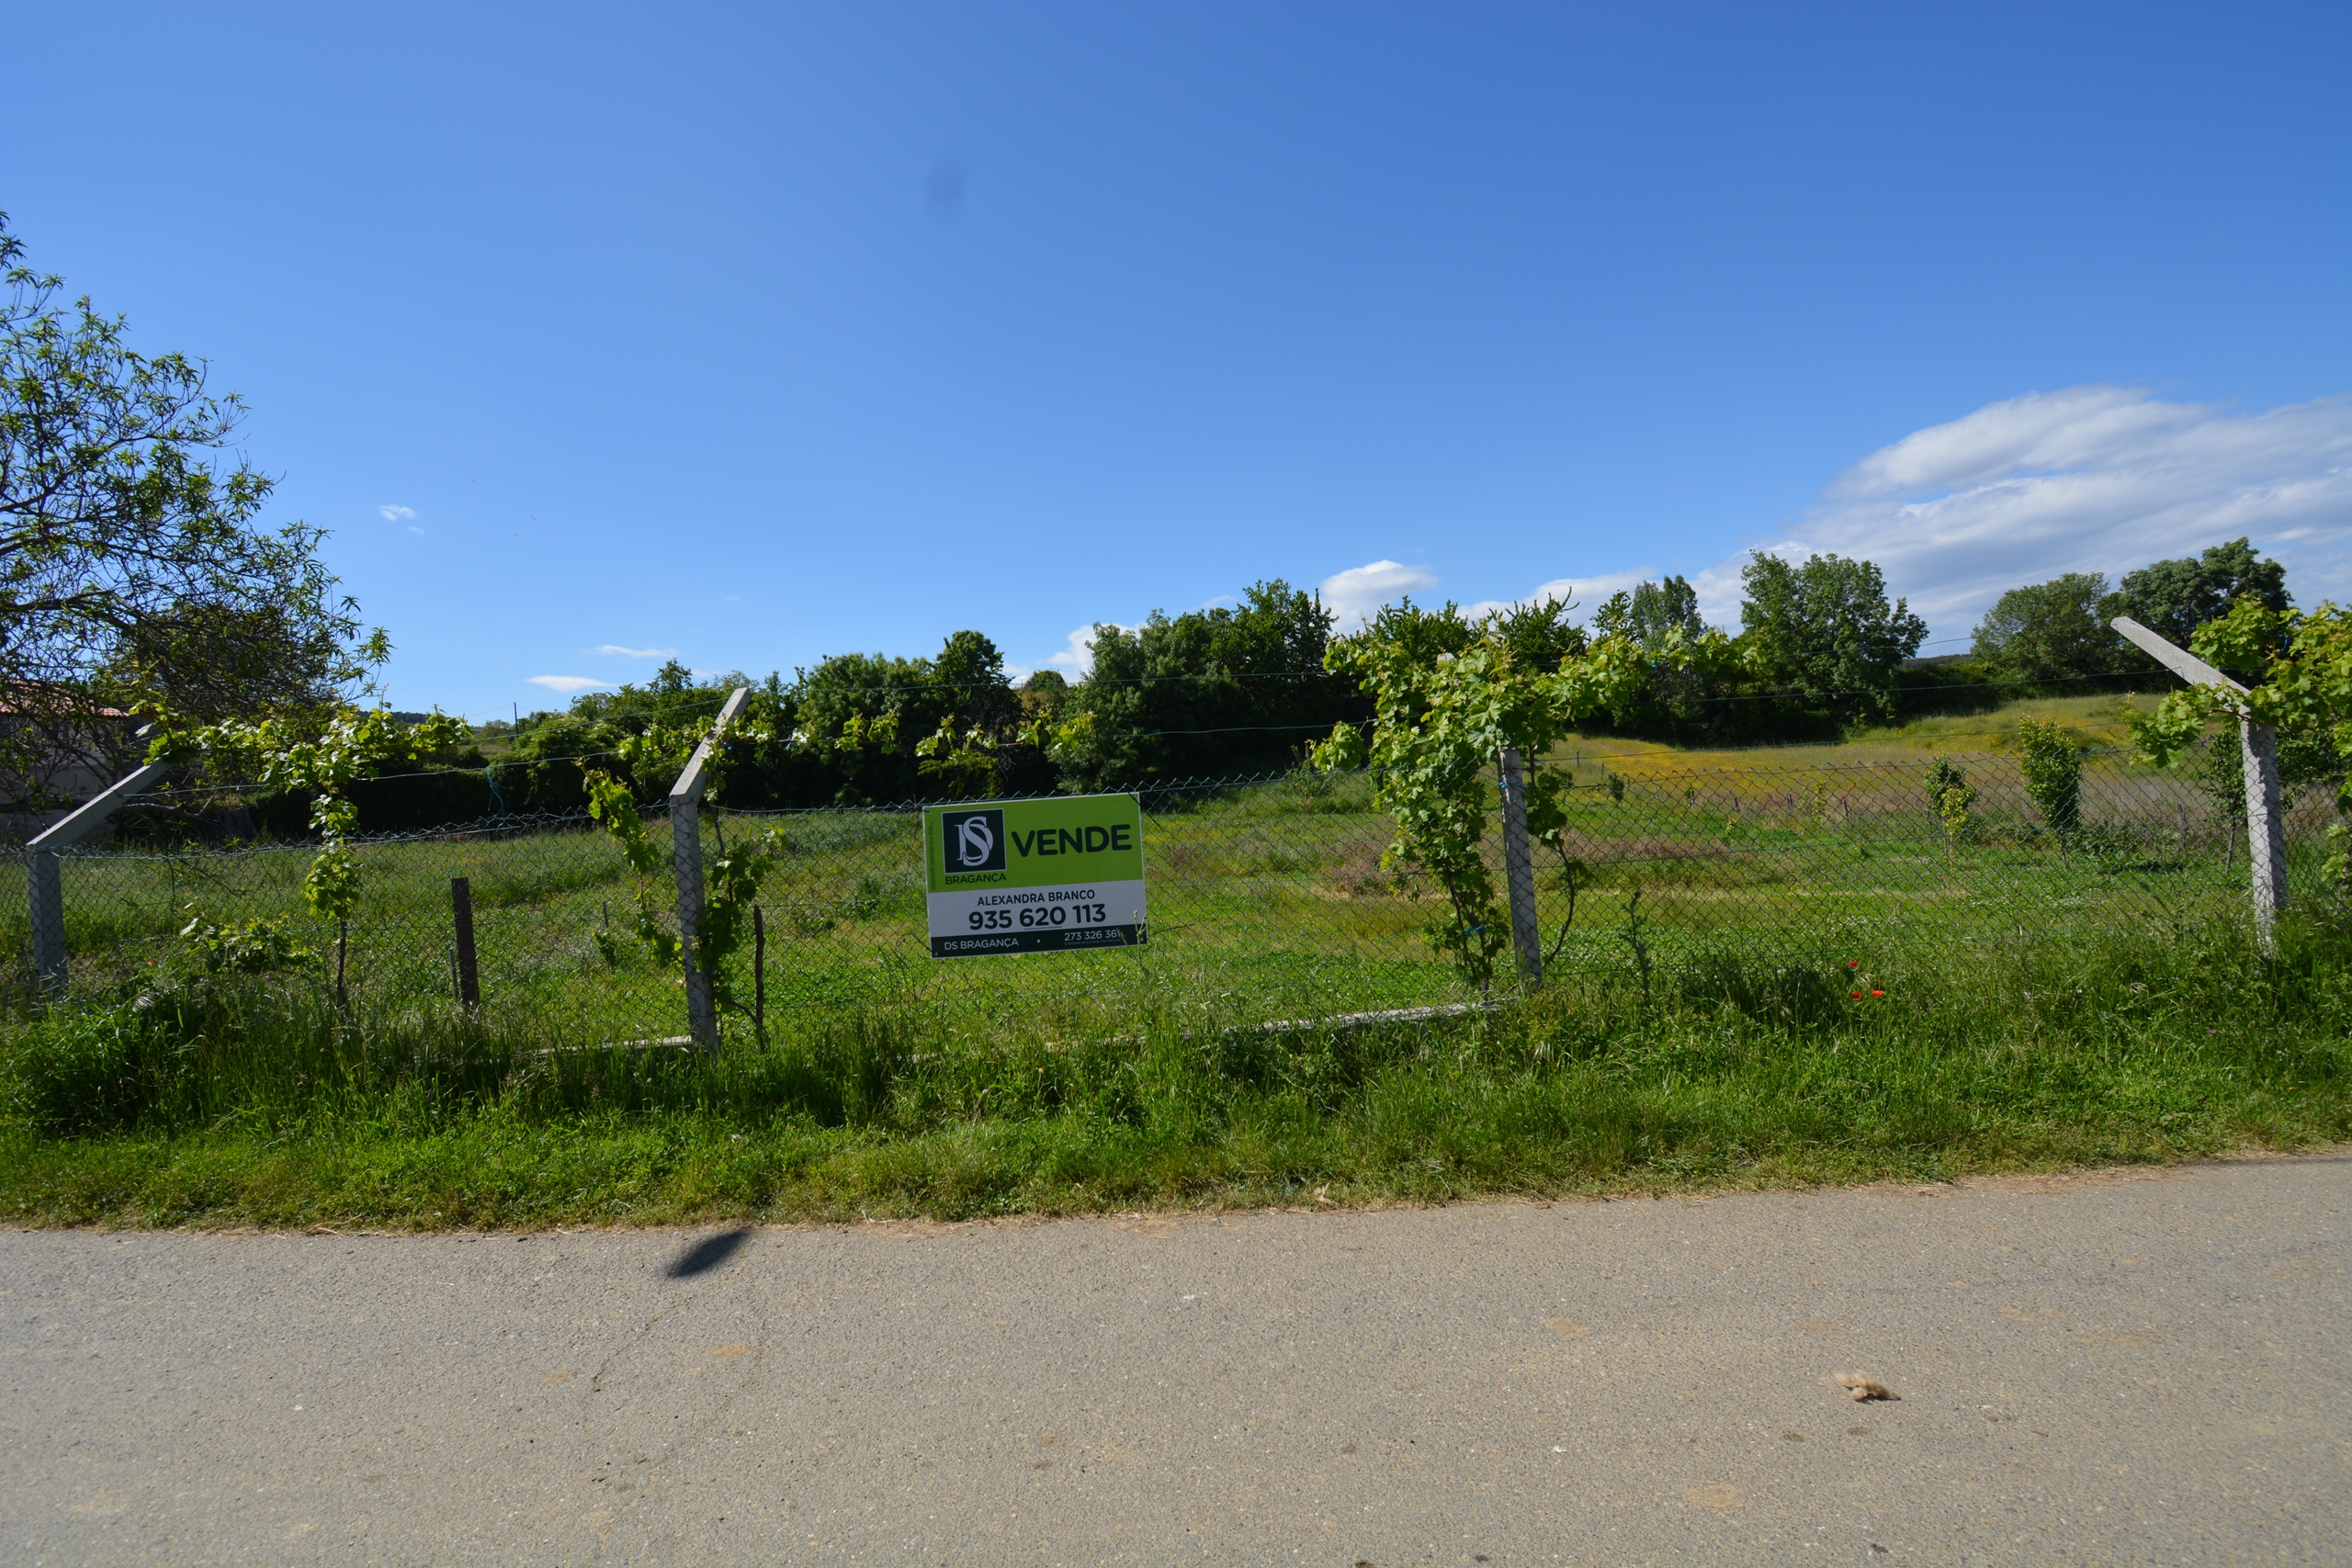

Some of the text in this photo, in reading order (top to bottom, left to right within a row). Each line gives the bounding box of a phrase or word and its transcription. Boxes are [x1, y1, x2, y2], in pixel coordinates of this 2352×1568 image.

[1011, 824, 1132, 857] VENDE
[945, 873, 1007, 885] BRAGANÇA
[977, 889, 1095, 907] ALEXANDRA BRANCO
[968, 903, 1106, 931] 935 620 113
[1064, 931, 1081, 942] 273
[1084, 930, 1102, 940] 326
[944, 938, 1019, 950] DS BRAGANÇA
